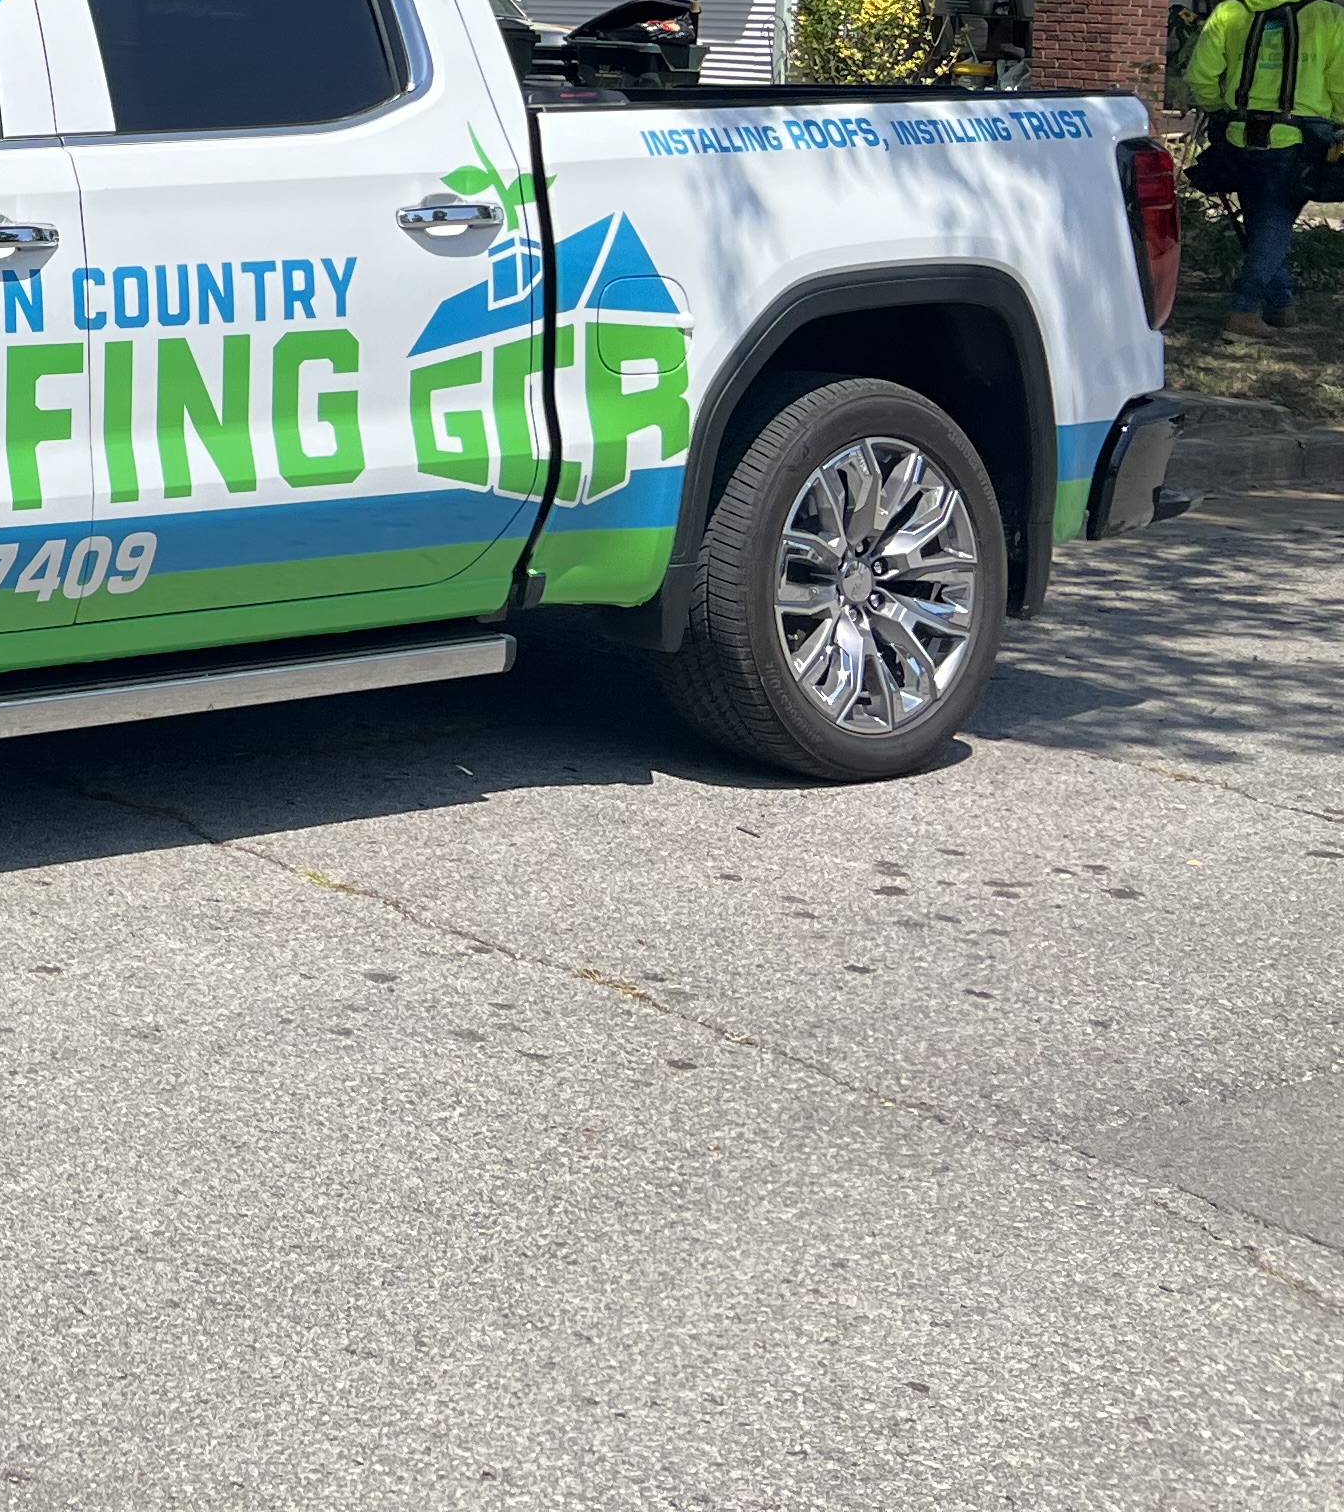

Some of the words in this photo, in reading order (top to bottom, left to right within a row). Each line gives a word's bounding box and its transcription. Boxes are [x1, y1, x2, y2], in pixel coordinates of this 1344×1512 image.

[640, 124, 782, 157] INSTALLING
[782, 116, 890, 152] ROOFS,
[890, 114, 1012, 148] INSTILLING
[1009, 110, 1093, 141] TRUST
[72, 255, 359, 332] COUNTRY
[407, 320, 692, 506] GCR
